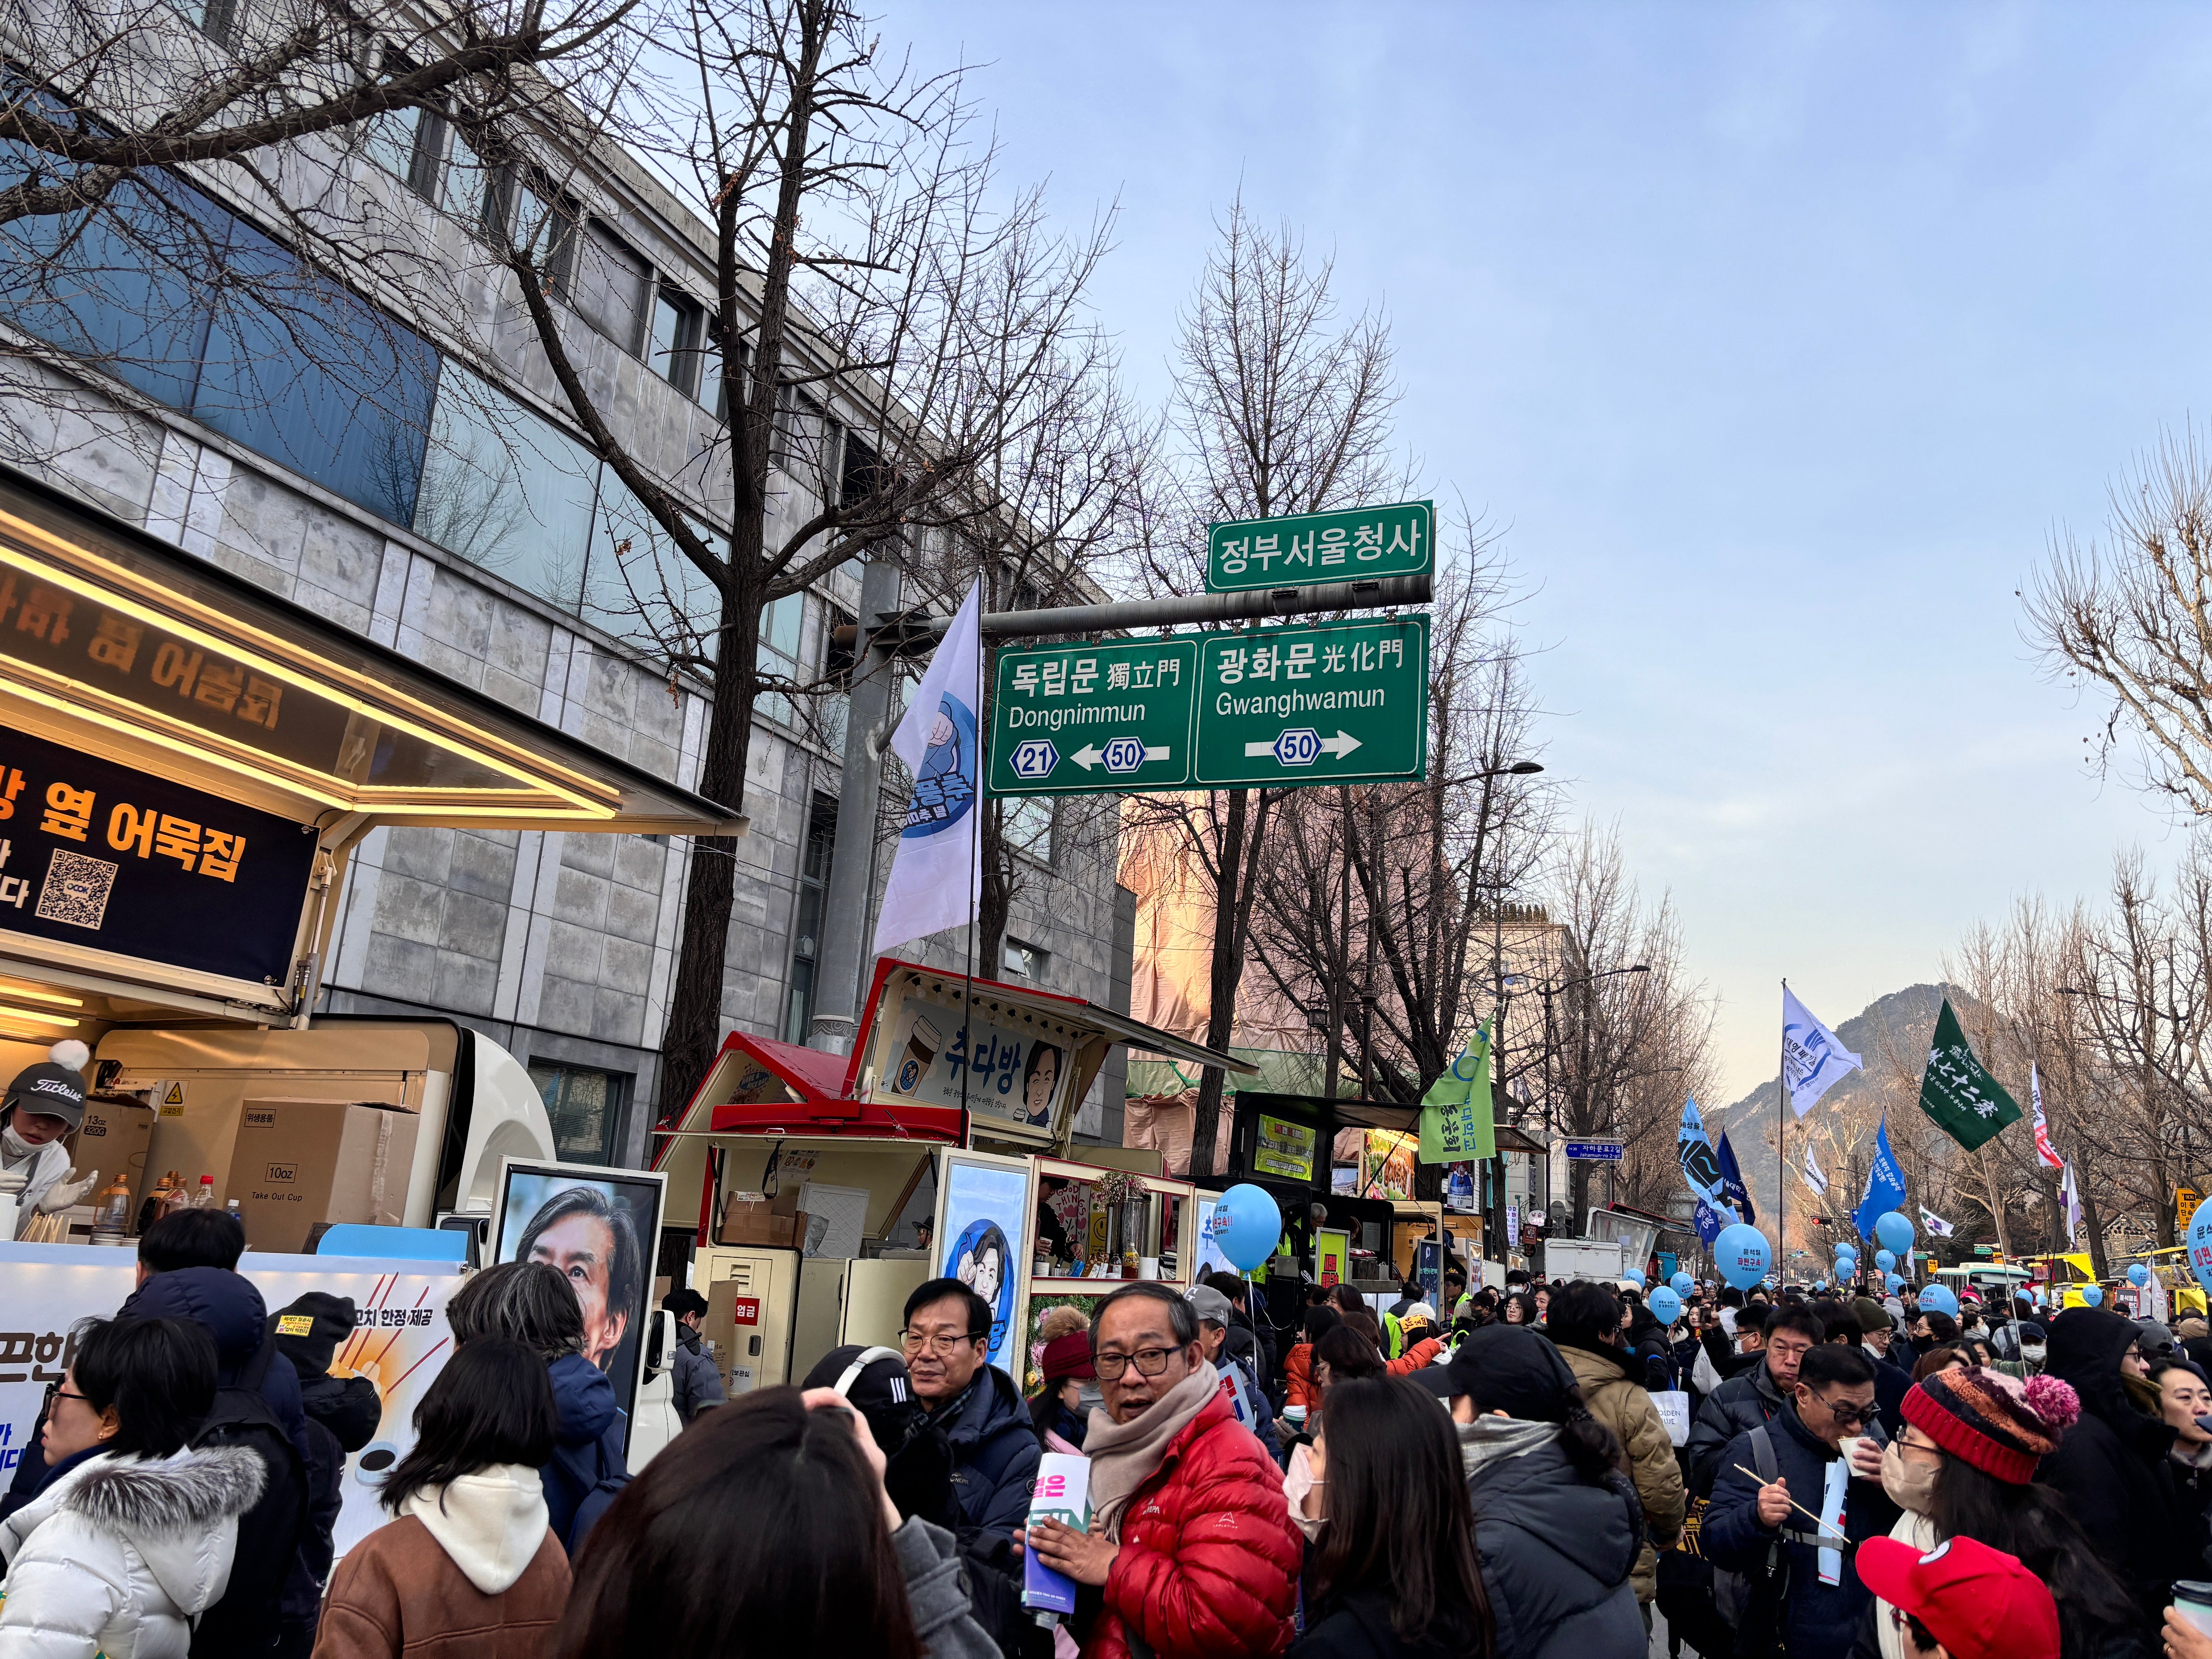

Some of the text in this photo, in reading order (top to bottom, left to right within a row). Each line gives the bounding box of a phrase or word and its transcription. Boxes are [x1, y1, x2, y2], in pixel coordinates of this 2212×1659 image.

[1219, 519, 1421, 574] 정부서울청사
[1217, 639, 1403, 685] 광화문 光化門
[1012, 658, 1180, 697] 독립문 獨立門
[1216, 688, 1385, 719] Gwanghwamun
[1009, 704, 1145, 732] Dongnimmun
[1111, 743, 1136, 768] 50
[1283, 734, 1312, 759] 50
[1022, 746, 1047, 772] 21
[40, 782, 96, 842] 옆
[107, 803, 246, 882] 어묵집
[945, 1025, 1021, 1095] 추다방
[31, 1079, 83, 1102] Titleist
[88, 1115, 106, 1125] 13oz
[246, 1113, 274, 1123] 위생용품
[85, 1126, 105, 1135] 320G
[1582, 1145, 1620, 1153] 자하문로2길
[269, 1166, 293, 1180] 10oz
[252, 1191, 302, 1202] Take Out Cup
[1056, 1185, 1079, 1196] GOOD
[1056, 1195, 1086, 1216] THINGS
[381, 1309, 407, 1326] 한정
[409, 1309, 433, 1326] 제공
[737, 1305, 755, 1317] 엄금
